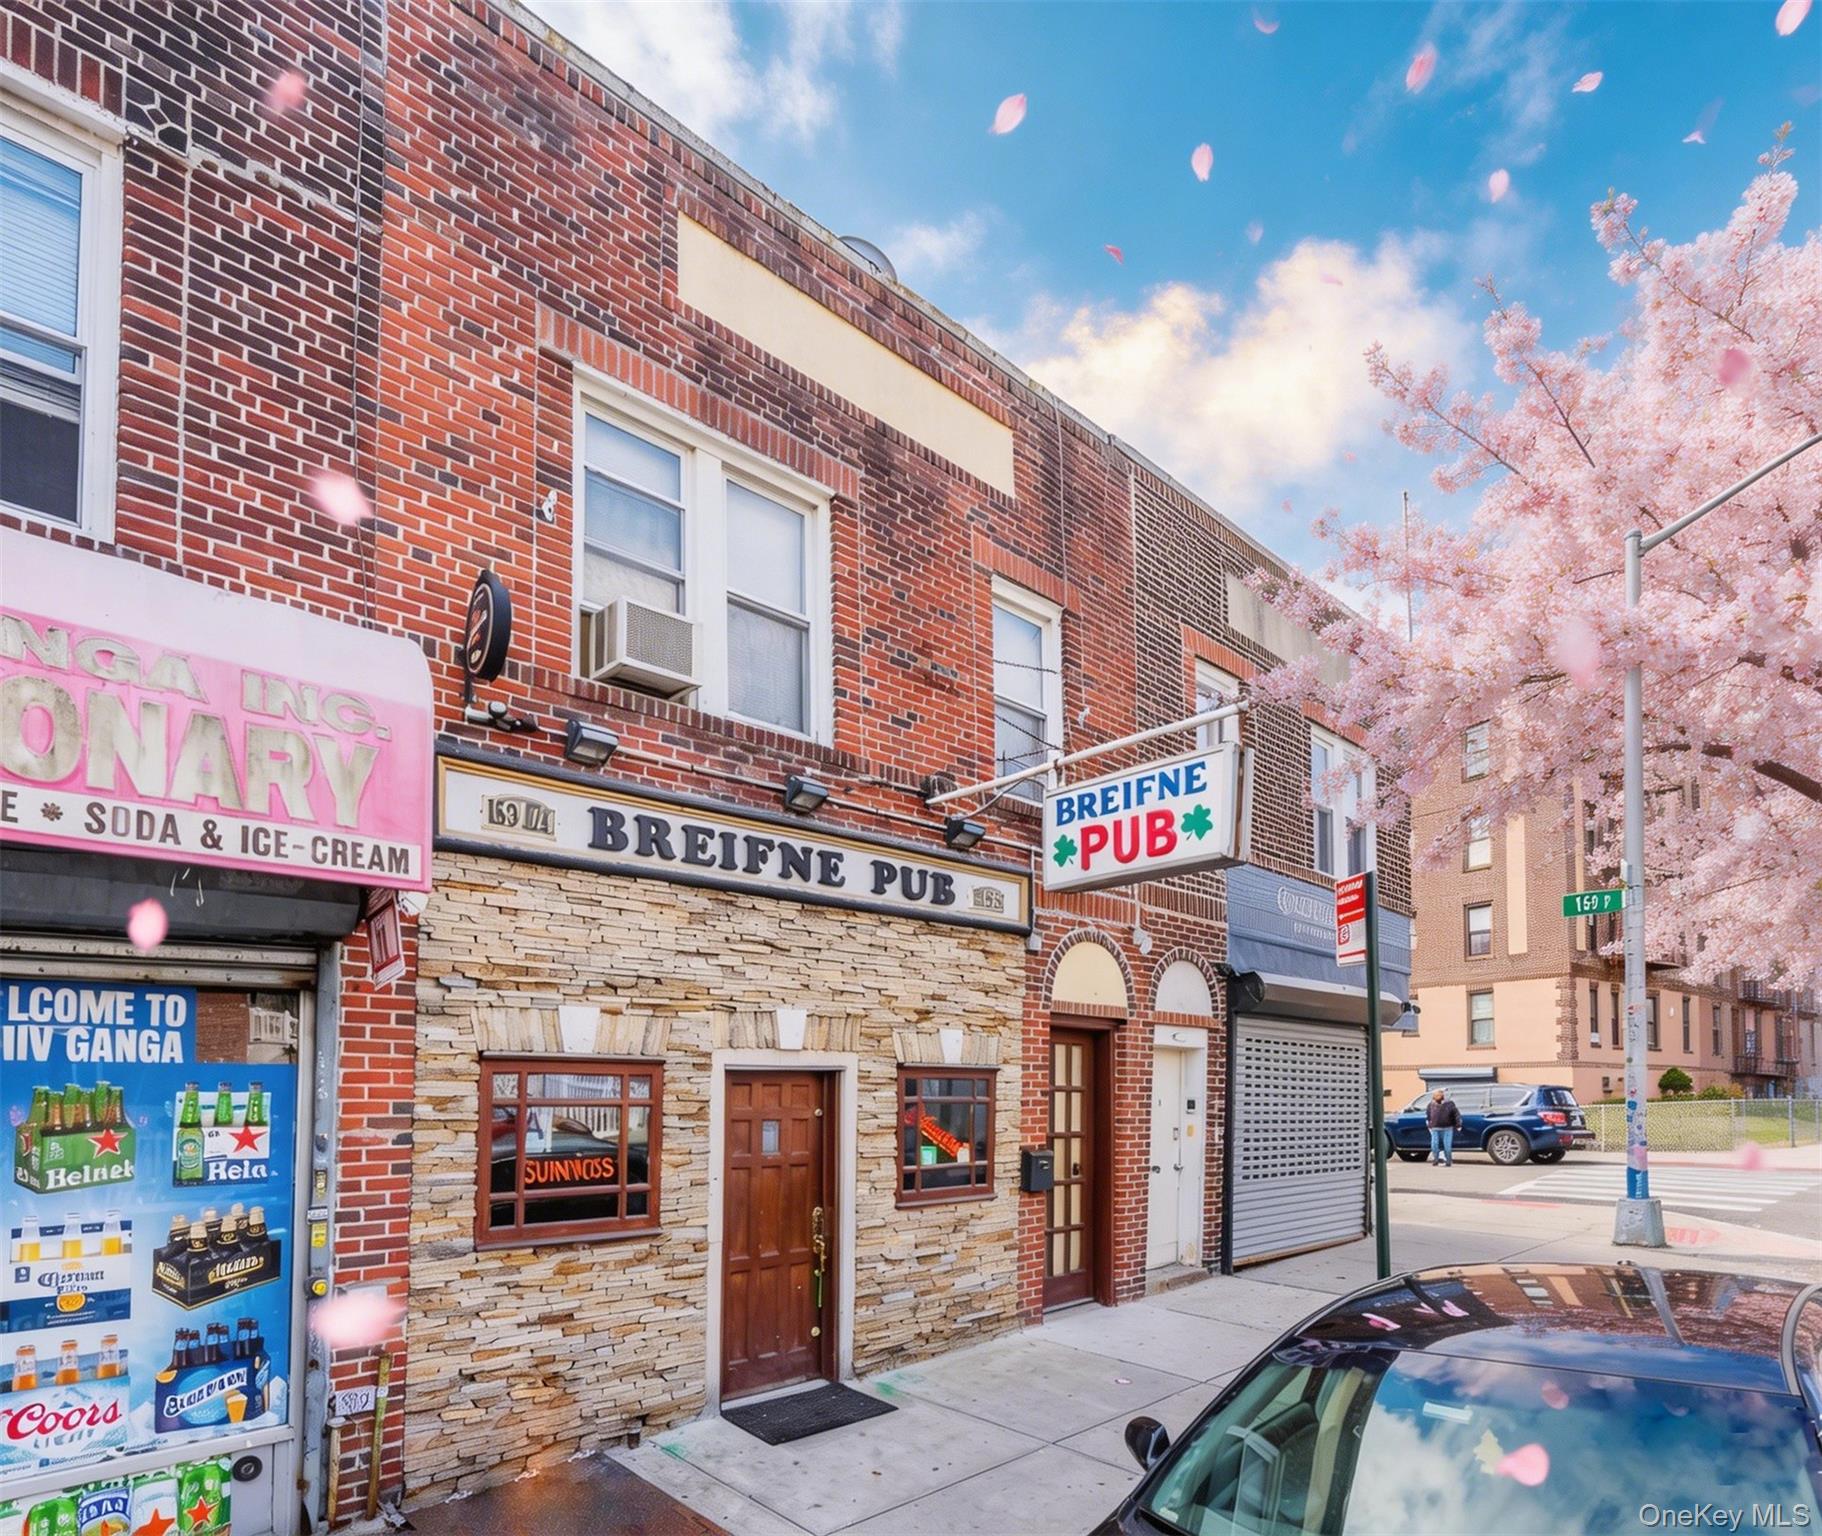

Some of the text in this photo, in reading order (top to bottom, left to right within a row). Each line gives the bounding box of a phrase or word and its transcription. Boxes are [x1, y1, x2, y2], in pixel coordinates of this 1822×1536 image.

[0, 614, 393, 742] NGA INC.
[0, 675, 380, 828] ONARY
[1056, 761, 1208, 827] BREIFNE
[0, 790, 410, 875] E SODA & ICE-CREAM
[587, 807, 956, 905] BREIFNE PUB
[1081, 809, 1178, 871] PUB
[0, 986, 187, 1028] LCOME TO
[66, 1026, 183, 1063] GANGA
[3, 1399, 122, 1440] Coors
